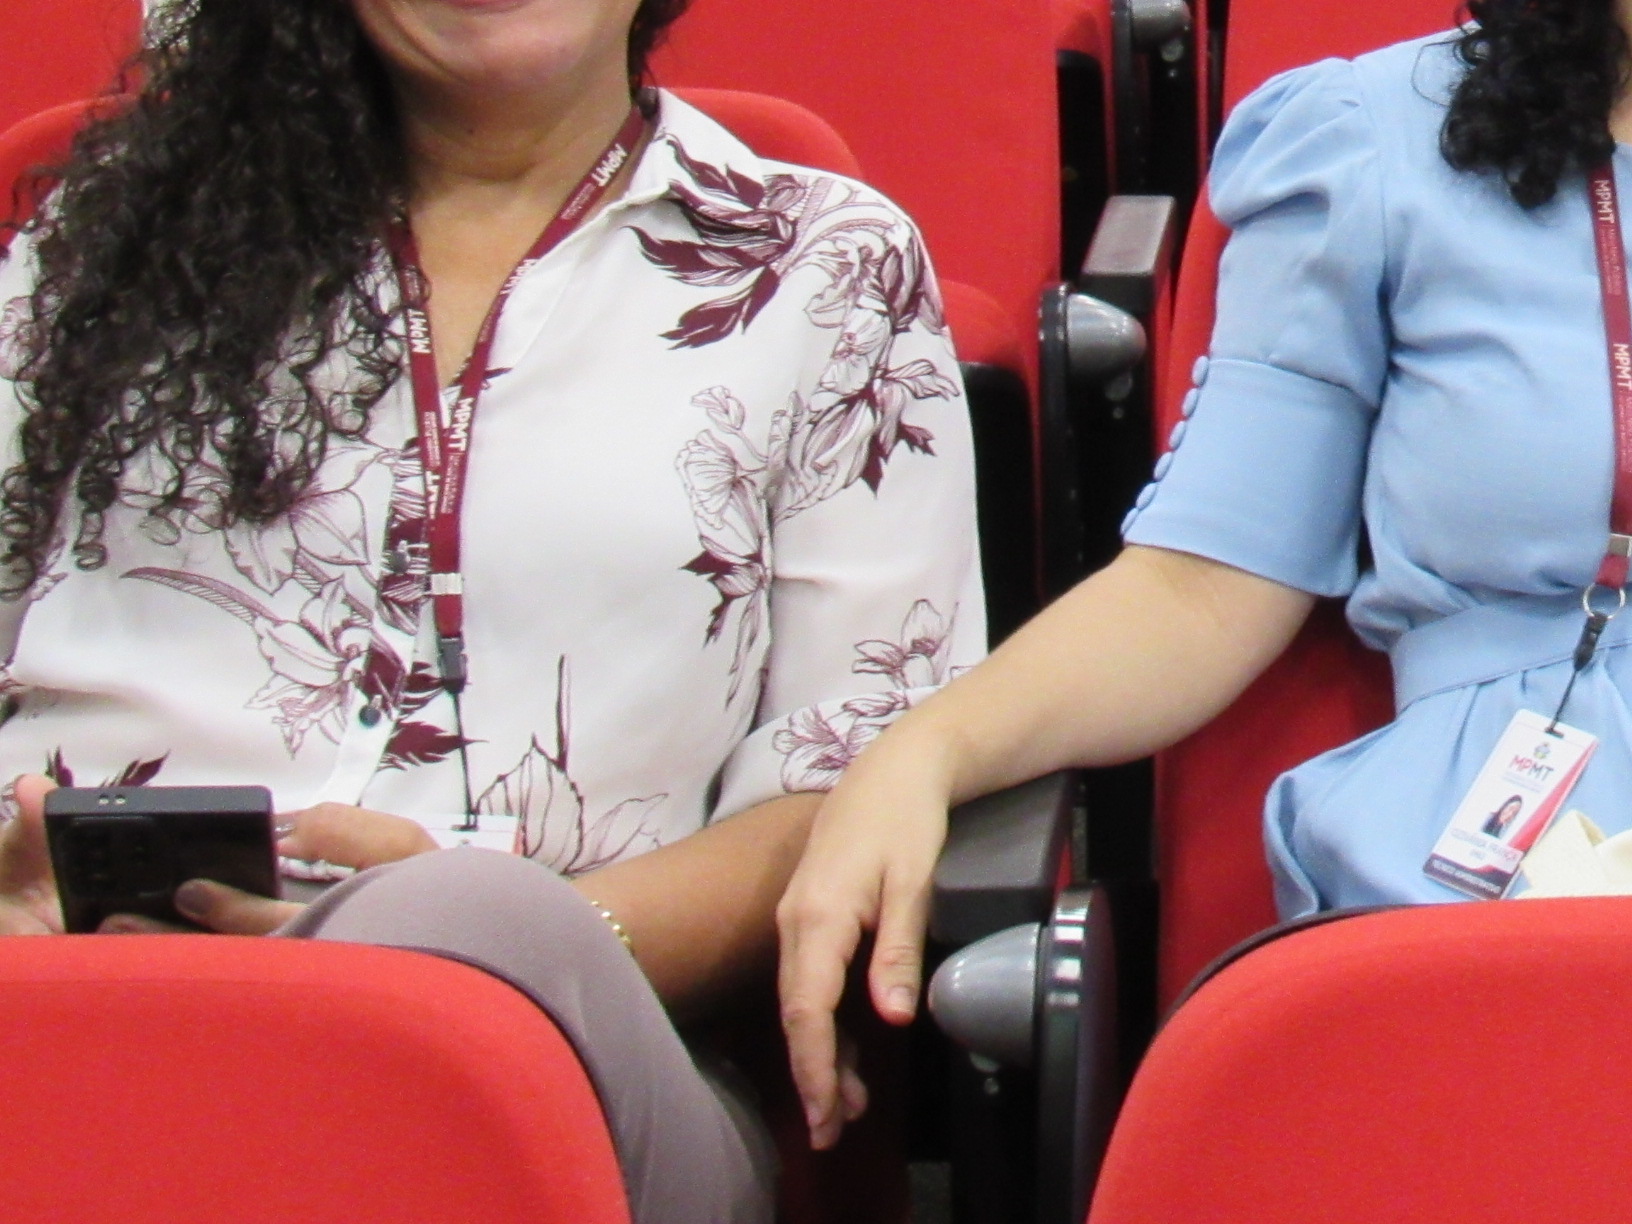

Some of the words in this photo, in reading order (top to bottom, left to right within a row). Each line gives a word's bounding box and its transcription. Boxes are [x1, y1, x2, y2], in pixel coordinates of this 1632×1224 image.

[591, 143, 628, 187] MPMT
[1594, 180, 1615, 224] MPMT
[407, 308, 432, 353] MPMT
[448, 397, 474, 451] MPMT
[1509, 755, 1554, 781] MPMT
